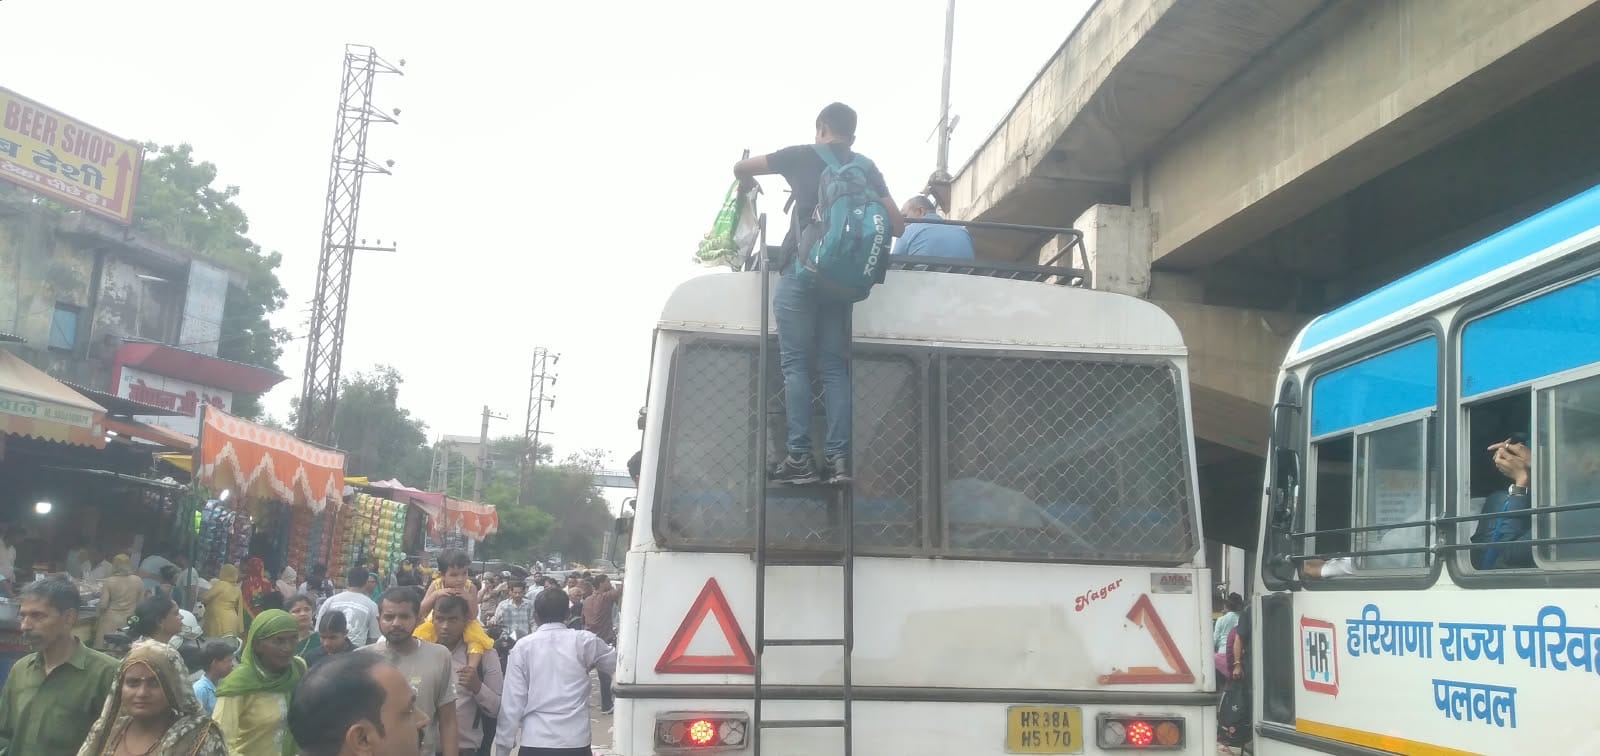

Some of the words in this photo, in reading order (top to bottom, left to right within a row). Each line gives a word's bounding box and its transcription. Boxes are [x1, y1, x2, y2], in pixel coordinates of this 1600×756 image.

[4, 100, 58, 147] BEER
[61, 123, 115, 167] SHOP
[31, 149, 106, 190] देशी
[1074, 578, 1123, 612] Nagar
[1308, 630, 1330, 674] HR
[1346, 604, 1433, 658] हरियाणा
[1439, 622, 1506, 664] राज्य
[1432, 679, 1517, 728] पलवल
